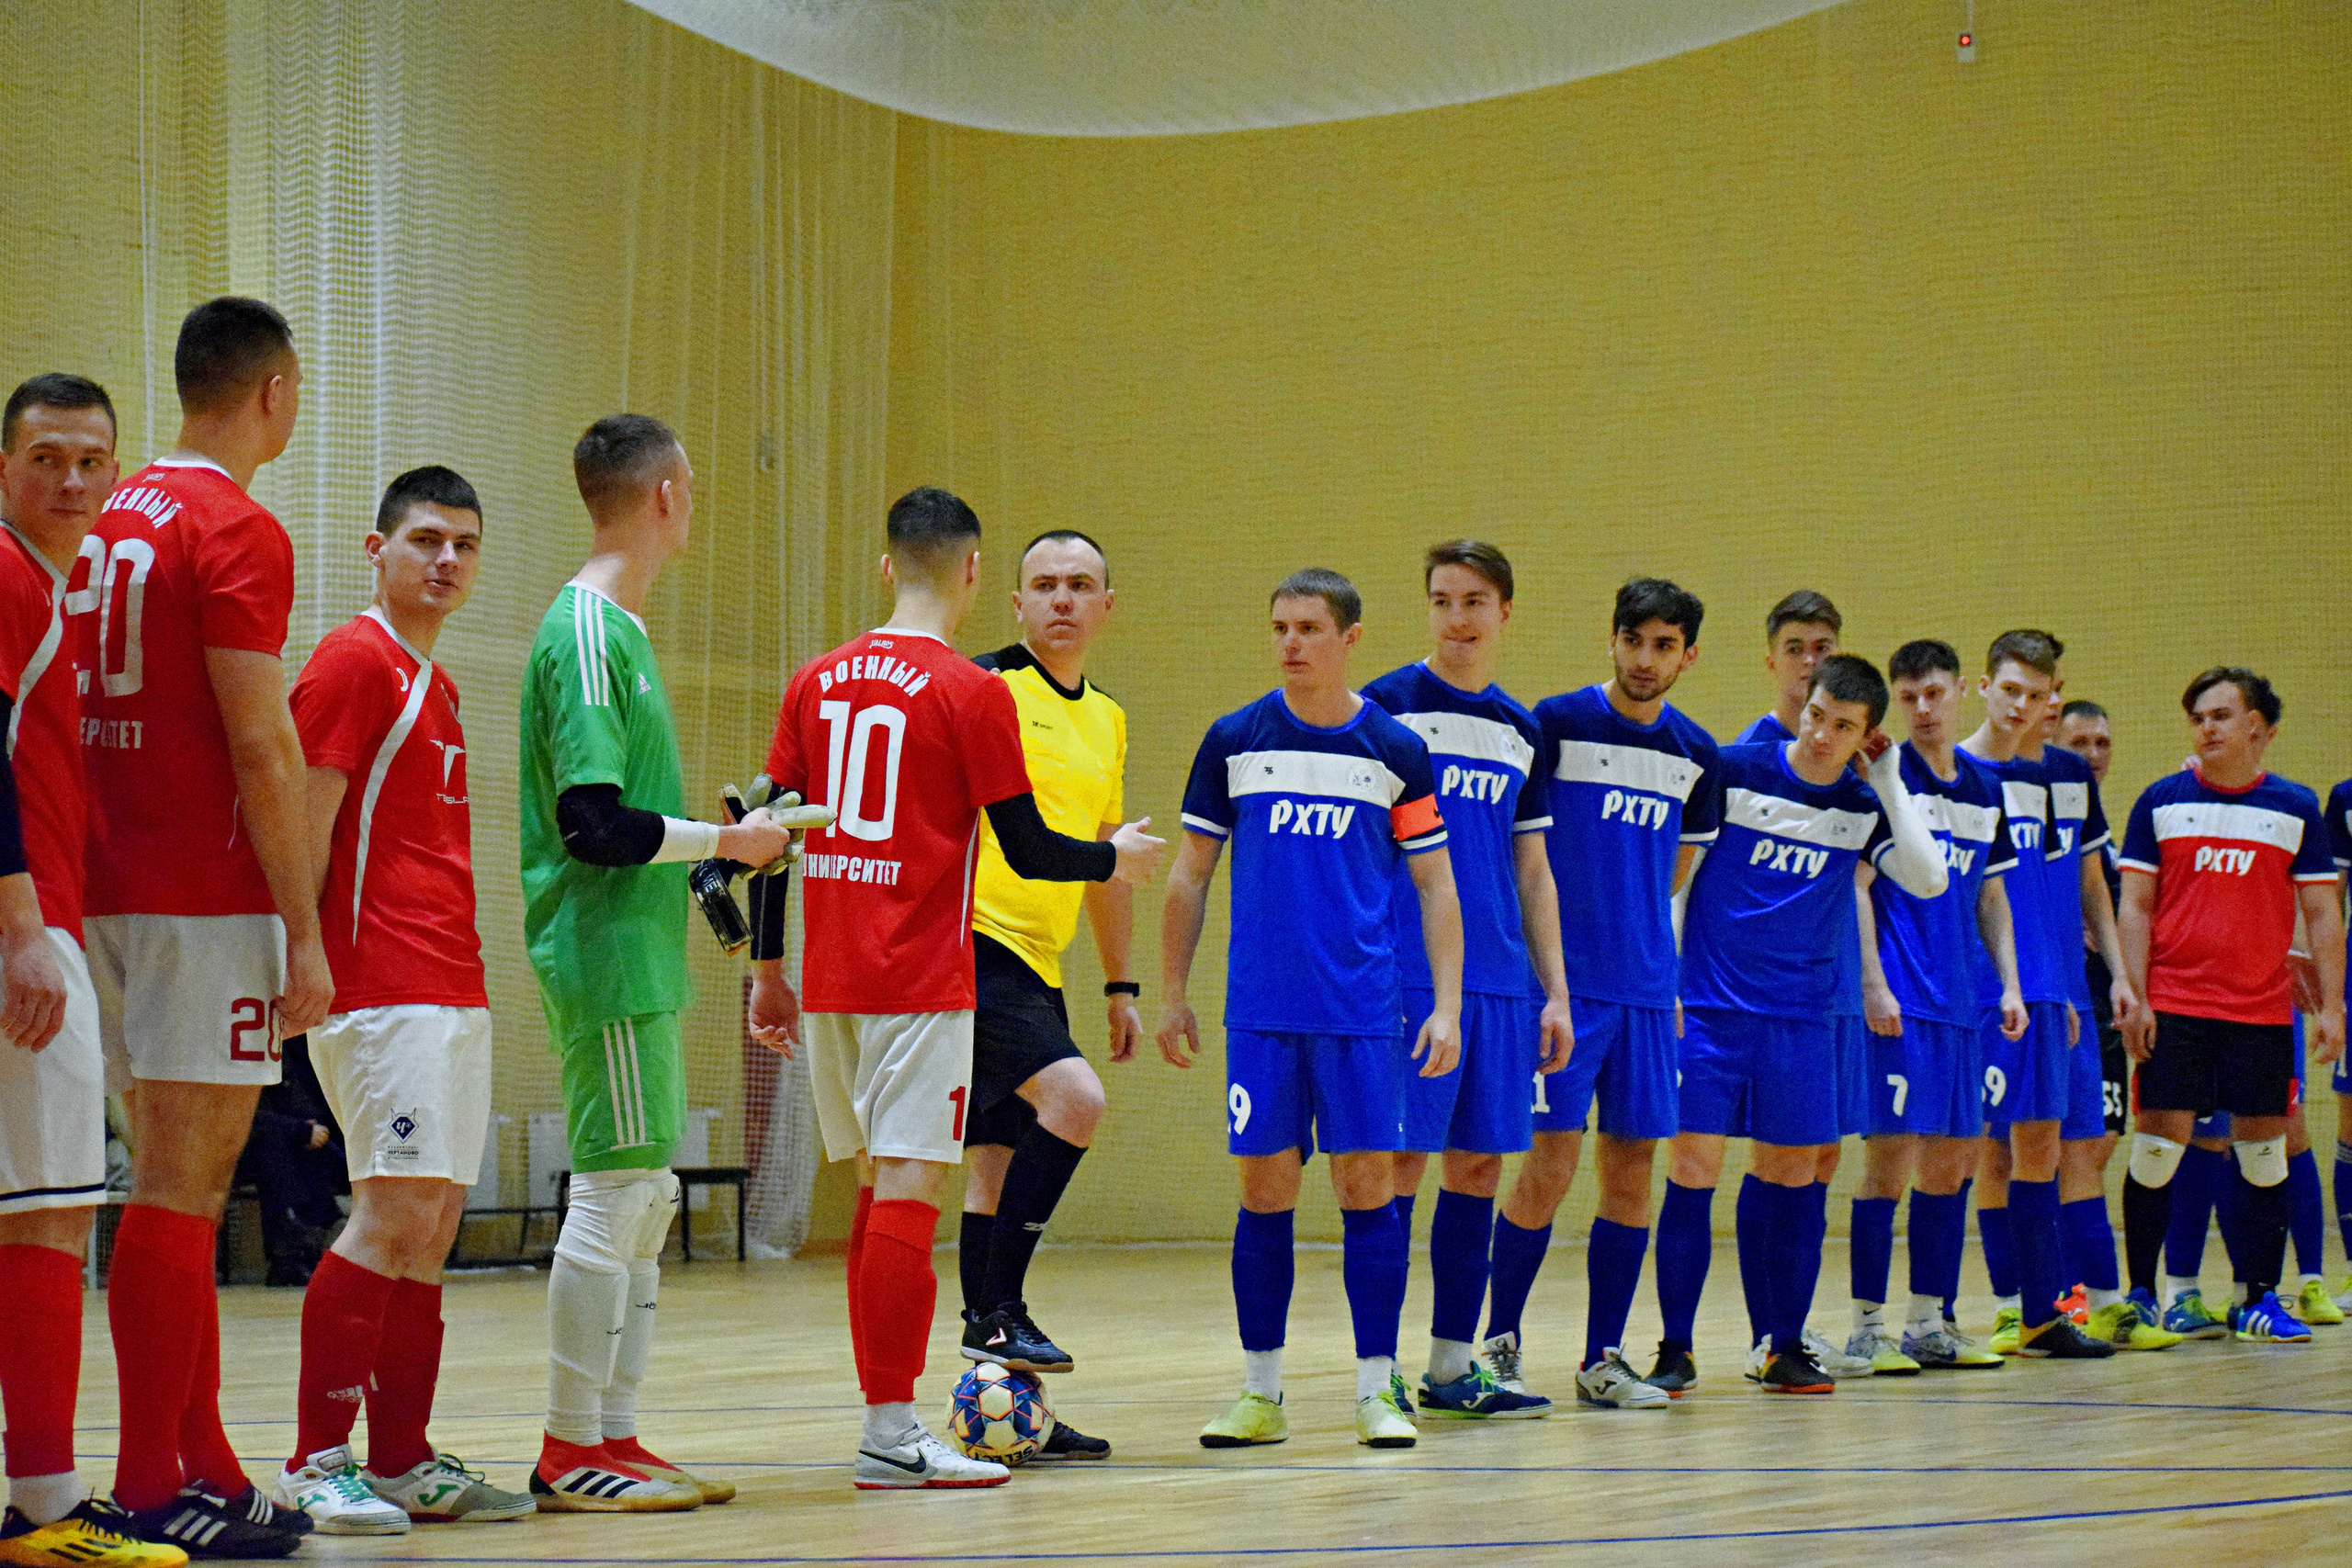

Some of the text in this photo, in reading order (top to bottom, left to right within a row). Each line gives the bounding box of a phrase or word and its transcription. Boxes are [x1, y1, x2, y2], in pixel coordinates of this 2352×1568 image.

[819, 655, 932, 698] ВОЕННЫЙ
[819, 700, 907, 841] 10
[1441, 764, 1510, 805] РХТУ
[1269, 799, 1355, 840] РХТУ
[1601, 790, 1669, 830] РХТУ
[1749, 839, 1829, 879] РХТУ
[2194, 845, 2256, 876] РХТУ
[231, 998, 282, 1062] 20
[1887, 1075, 1908, 1117] 7
[1982, 1066, 2007, 1107] 9
[949, 1086, 966, 1141] 1
[1227, 1083, 1251, 1135] 9
